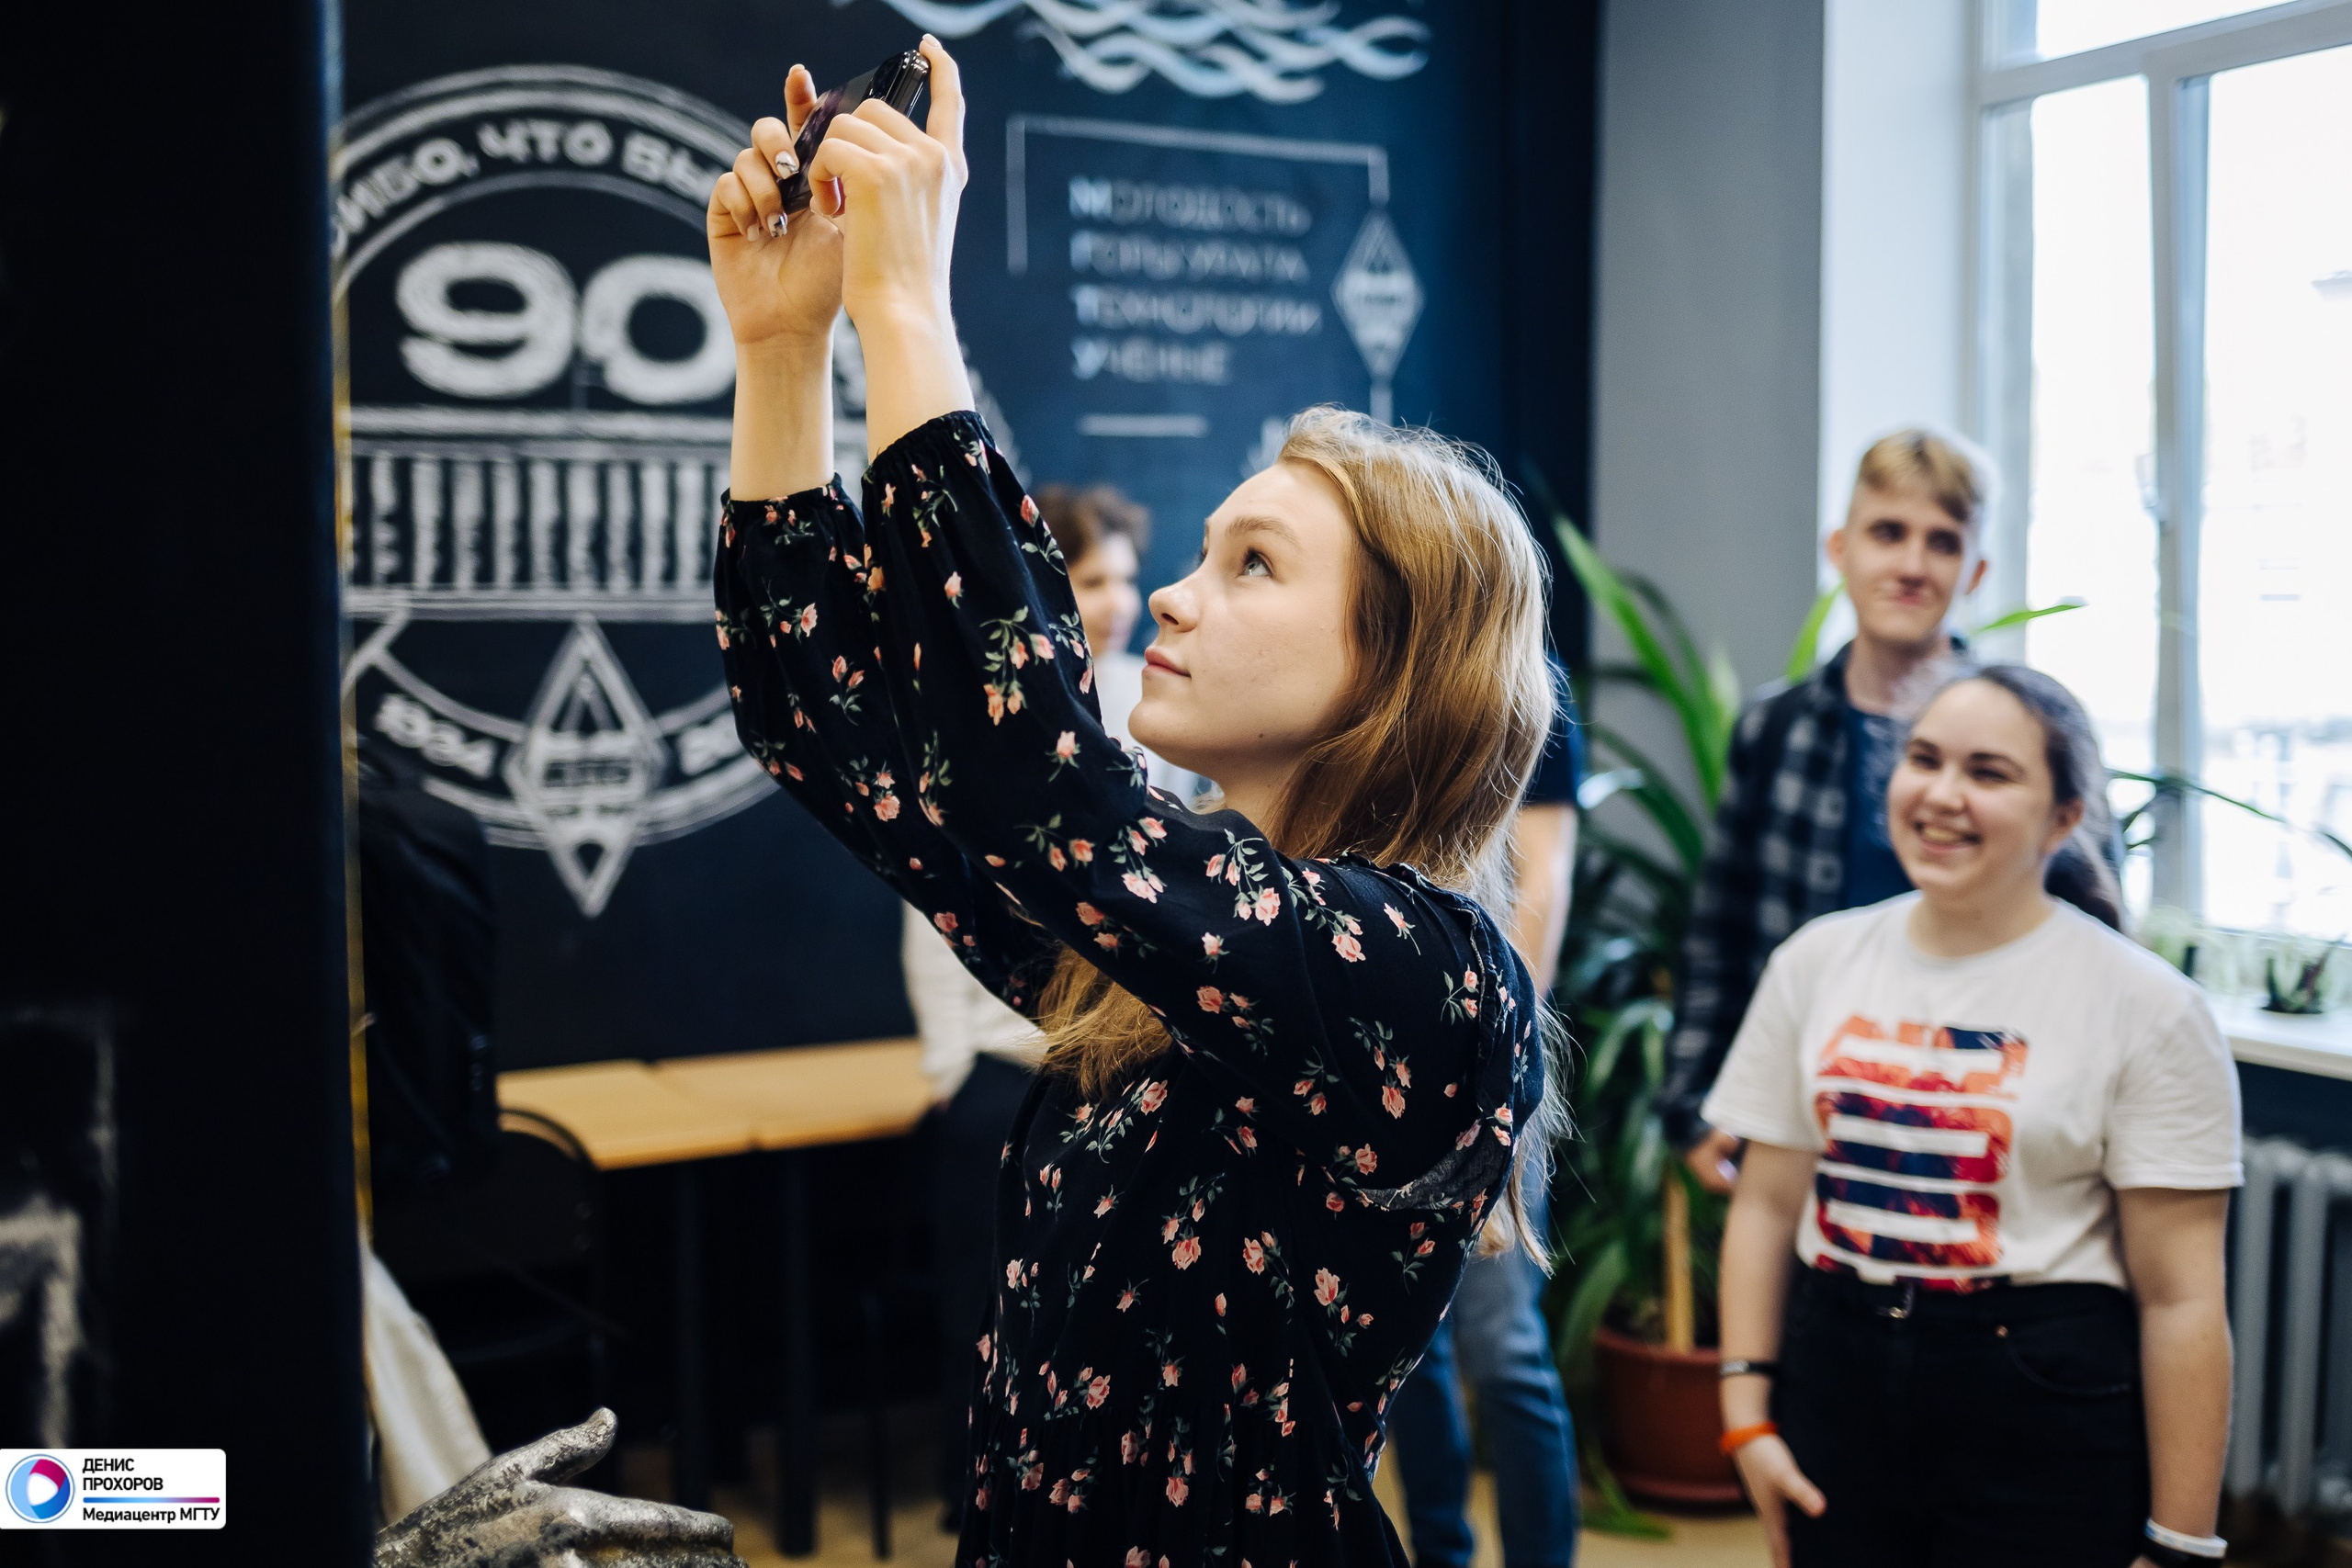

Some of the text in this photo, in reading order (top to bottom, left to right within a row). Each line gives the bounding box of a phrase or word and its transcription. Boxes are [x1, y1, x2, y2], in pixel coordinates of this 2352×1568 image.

[477, 118, 614, 167] ЧТО
[1070, 178, 1311, 233] МОЛОДОСТЬ
[395, 240, 738, 405] 90
[1071, 284, 1322, 336] ТЕХНОЛОГИИ
